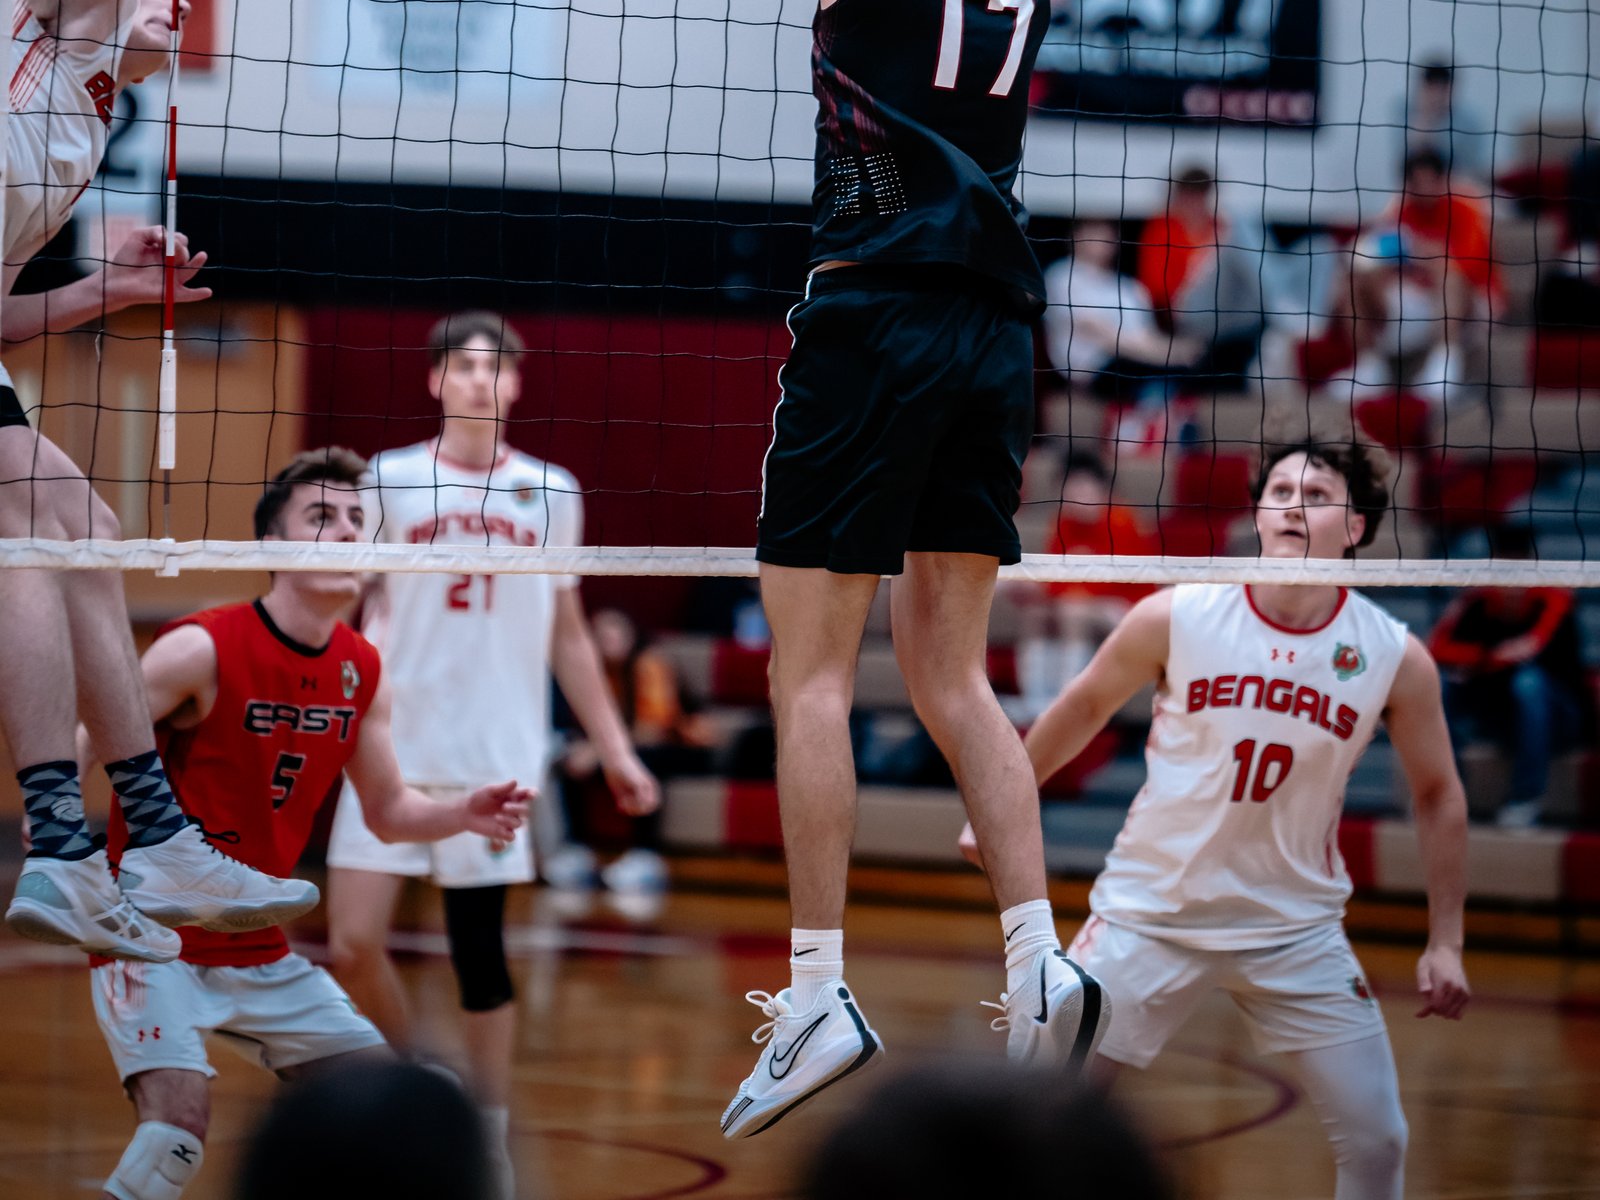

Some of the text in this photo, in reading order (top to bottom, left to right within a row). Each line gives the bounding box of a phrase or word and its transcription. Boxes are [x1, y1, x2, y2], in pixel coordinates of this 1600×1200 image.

[446, 573, 494, 613] 21
[243, 698, 356, 742] EAST
[1186, 674, 1359, 742] BENGALS
[270, 750, 307, 813] 5
[1230, 737, 1294, 804] 10
